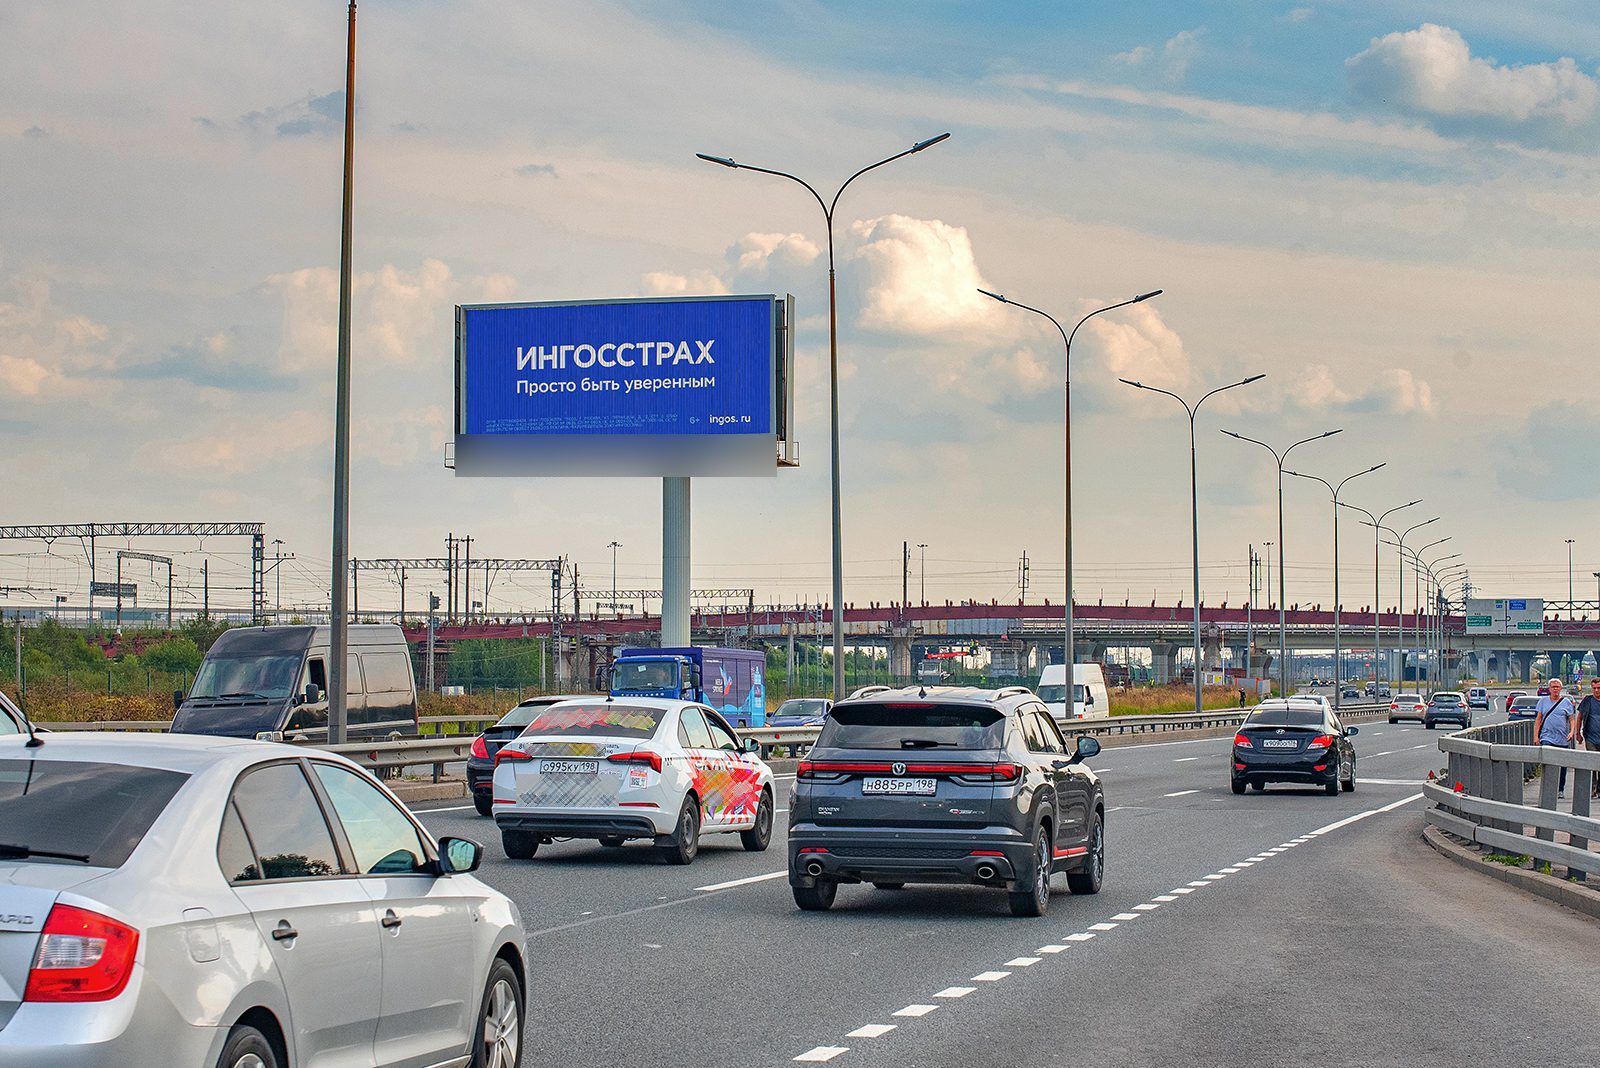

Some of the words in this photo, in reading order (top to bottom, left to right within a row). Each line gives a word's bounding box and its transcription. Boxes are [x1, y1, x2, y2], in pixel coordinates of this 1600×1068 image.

[516, 339, 716, 371] ИНГОССТРАХ
[516, 380, 577, 397] Просто
[580, 377, 620, 392] быть
[624, 376, 716, 394] уверенным
[689, 416, 700, 425] 6+
[580, 762, 595, 770] 198
[915, 779, 933, 788] 198
